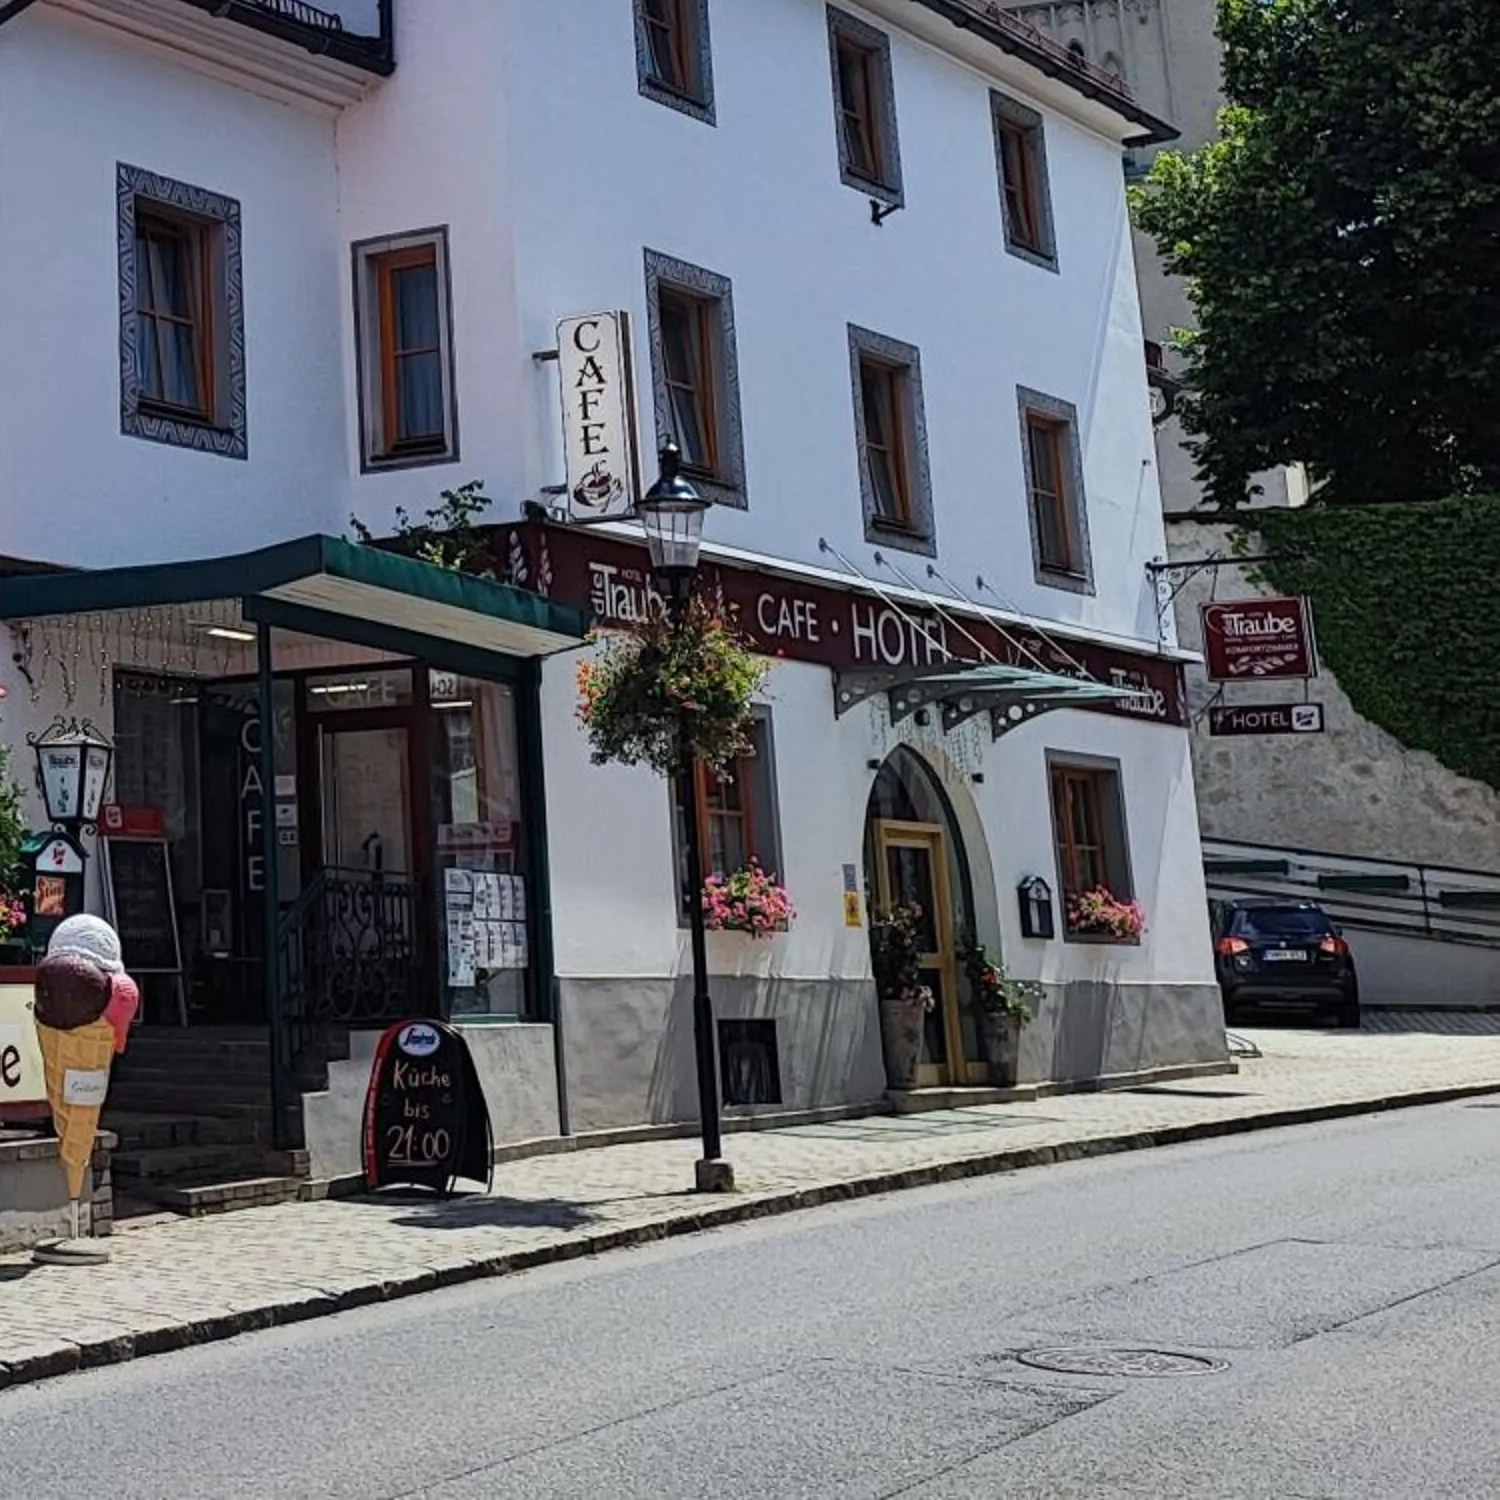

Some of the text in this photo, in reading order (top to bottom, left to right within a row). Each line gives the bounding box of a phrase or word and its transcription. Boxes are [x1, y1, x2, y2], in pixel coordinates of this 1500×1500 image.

[573, 321, 611, 456] CAFE
[757, 592, 820, 642] CAFE
[1220, 611, 1297, 637] Traube
[1231, 710, 1290, 729] HOTEL
[240, 718, 265, 891] CAFE
[392, 1059, 452, 1090] Küche
[403, 1098, 429, 1119] bis
[387, 1123, 450, 1163] 21:00
